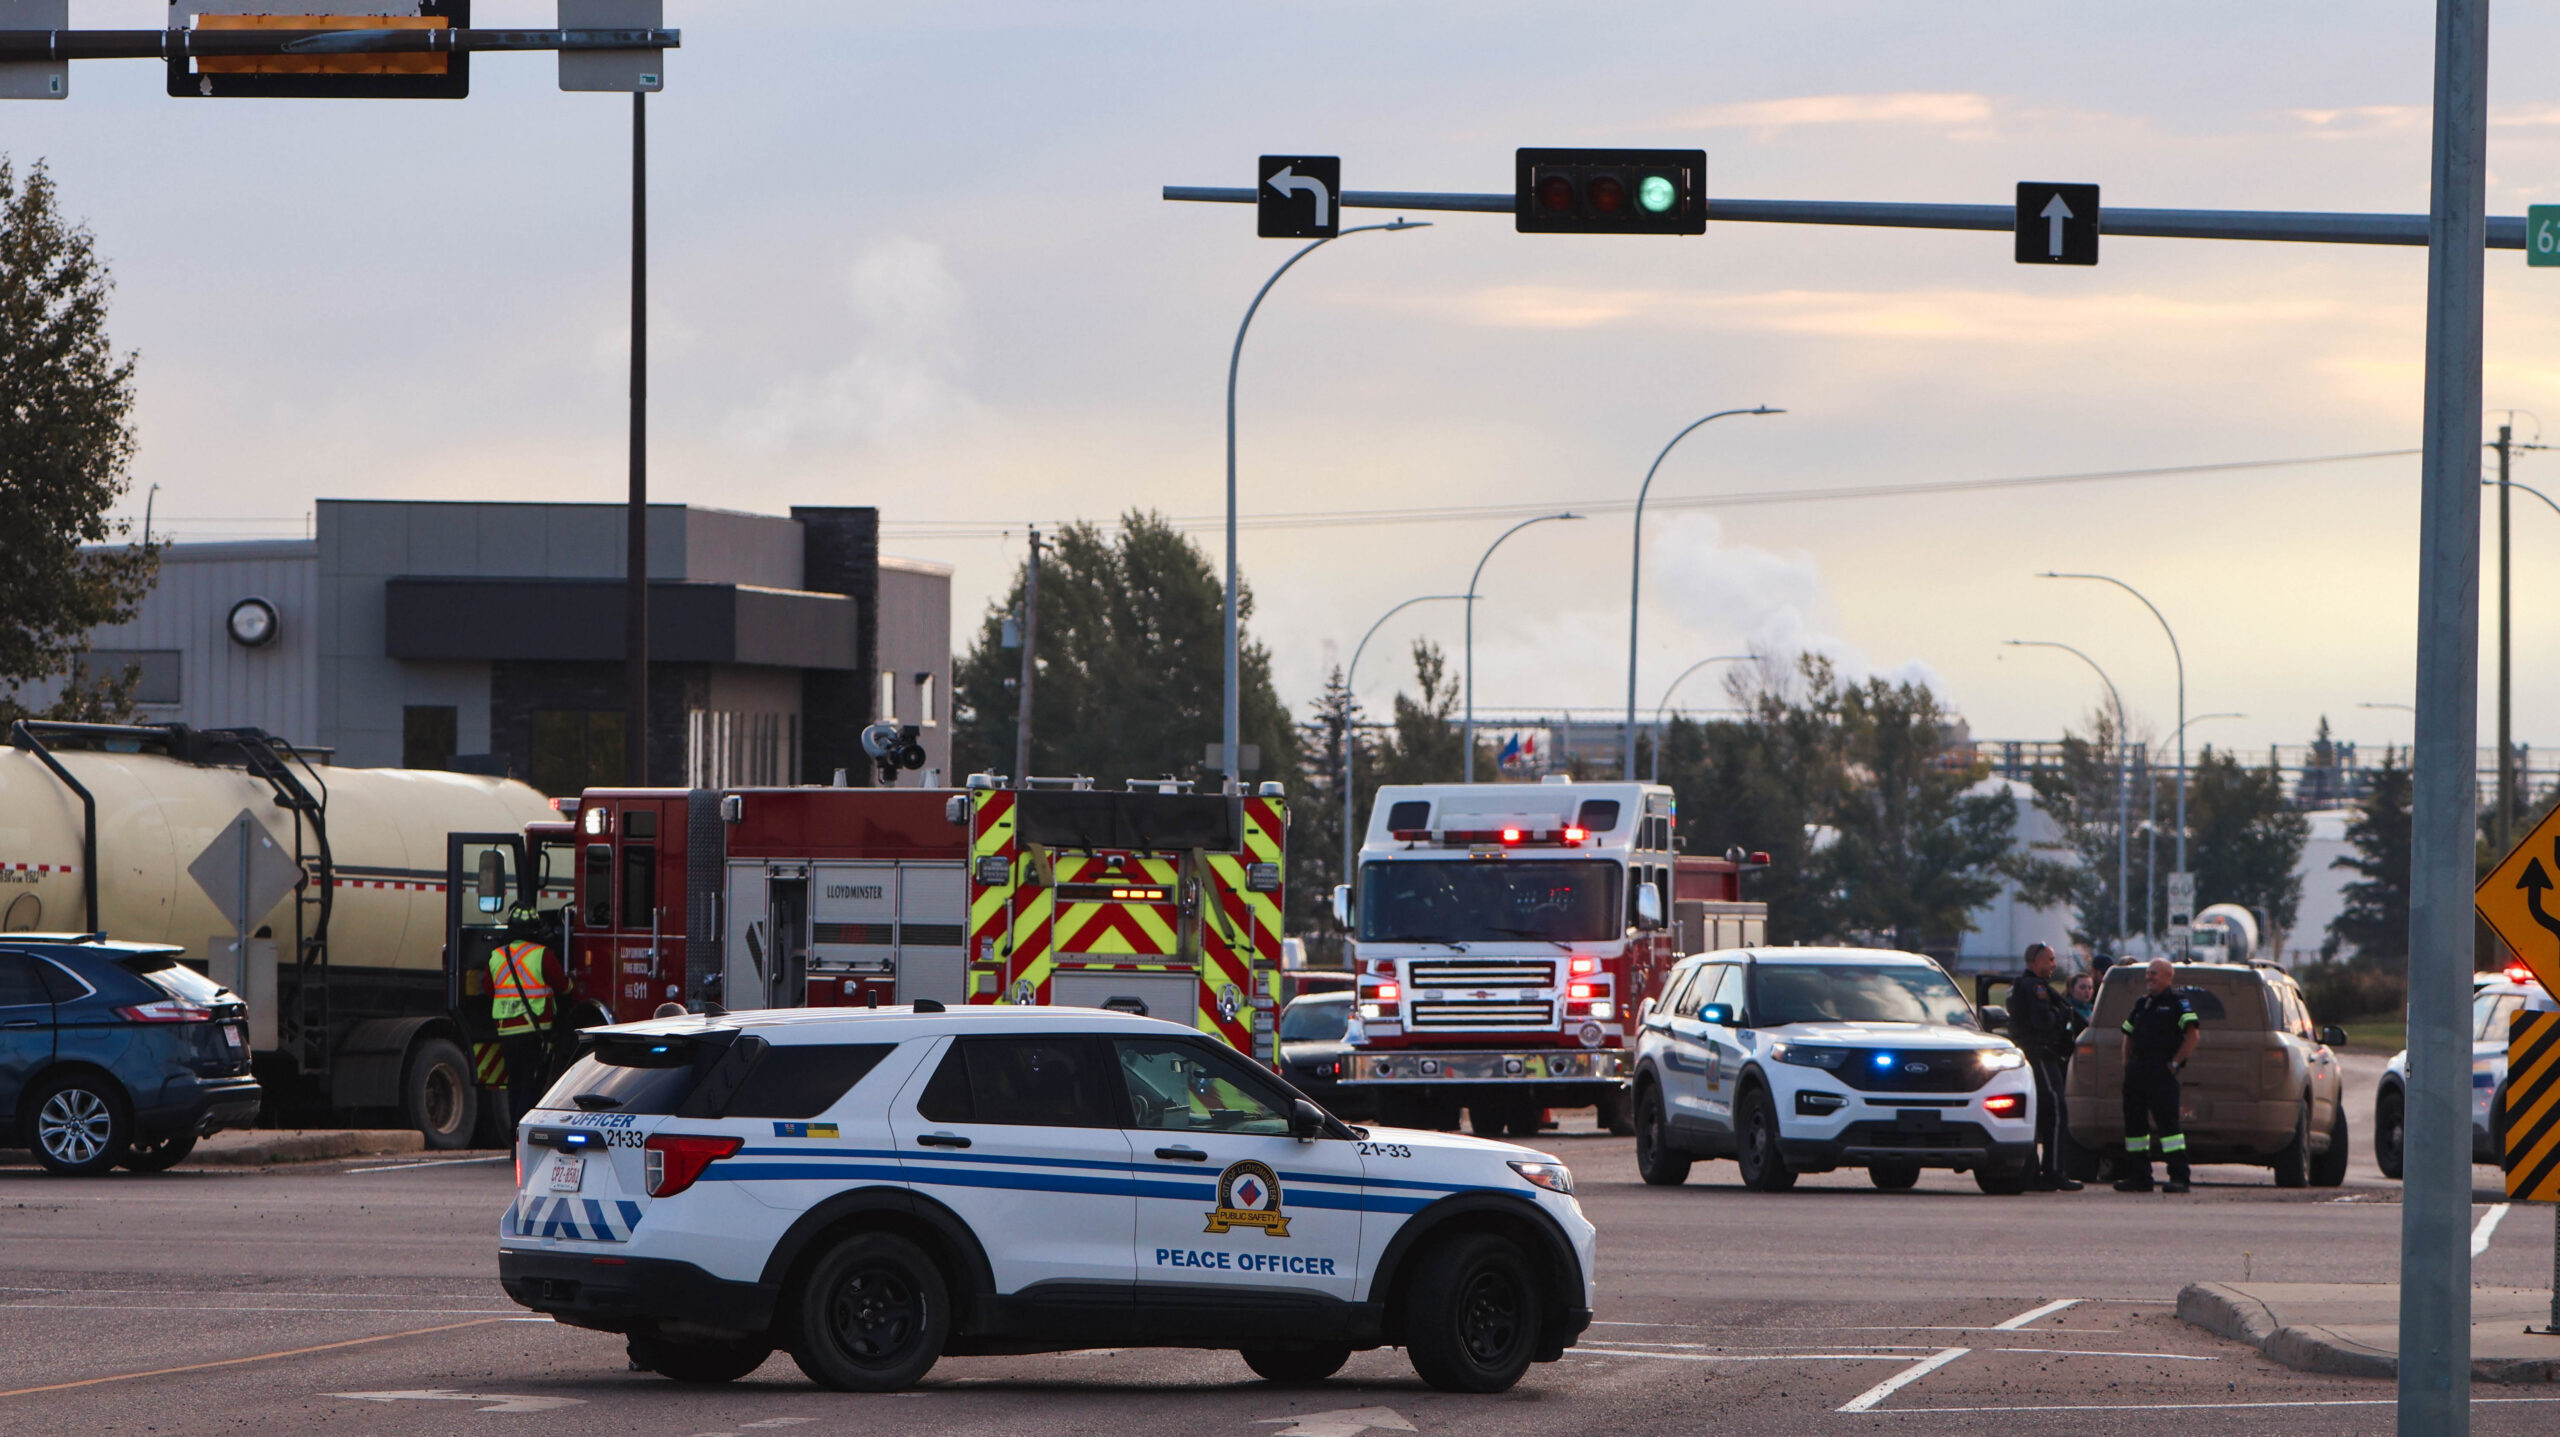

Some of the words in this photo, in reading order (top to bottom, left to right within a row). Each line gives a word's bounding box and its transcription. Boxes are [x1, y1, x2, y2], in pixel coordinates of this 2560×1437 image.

[826, 884, 883, 900] LLOYDMINSTER
[633, 981, 648, 1000] 911
[571, 1112, 637, 1129] OFFICER
[606, 1128, 644, 1149] 21-33
[1356, 1141, 1412, 1159] 21-33
[1226, 1170, 1237, 1180] OF
[1237, 1163, 1278, 1201] LLOYDMINSTER
[1220, 1211, 1247, 1222] PUBLIC
[1247, 1213, 1277, 1223] SAFETY
[1156, 1248, 1231, 1270] PEACE
[1237, 1253, 1337, 1276] OFFICER
